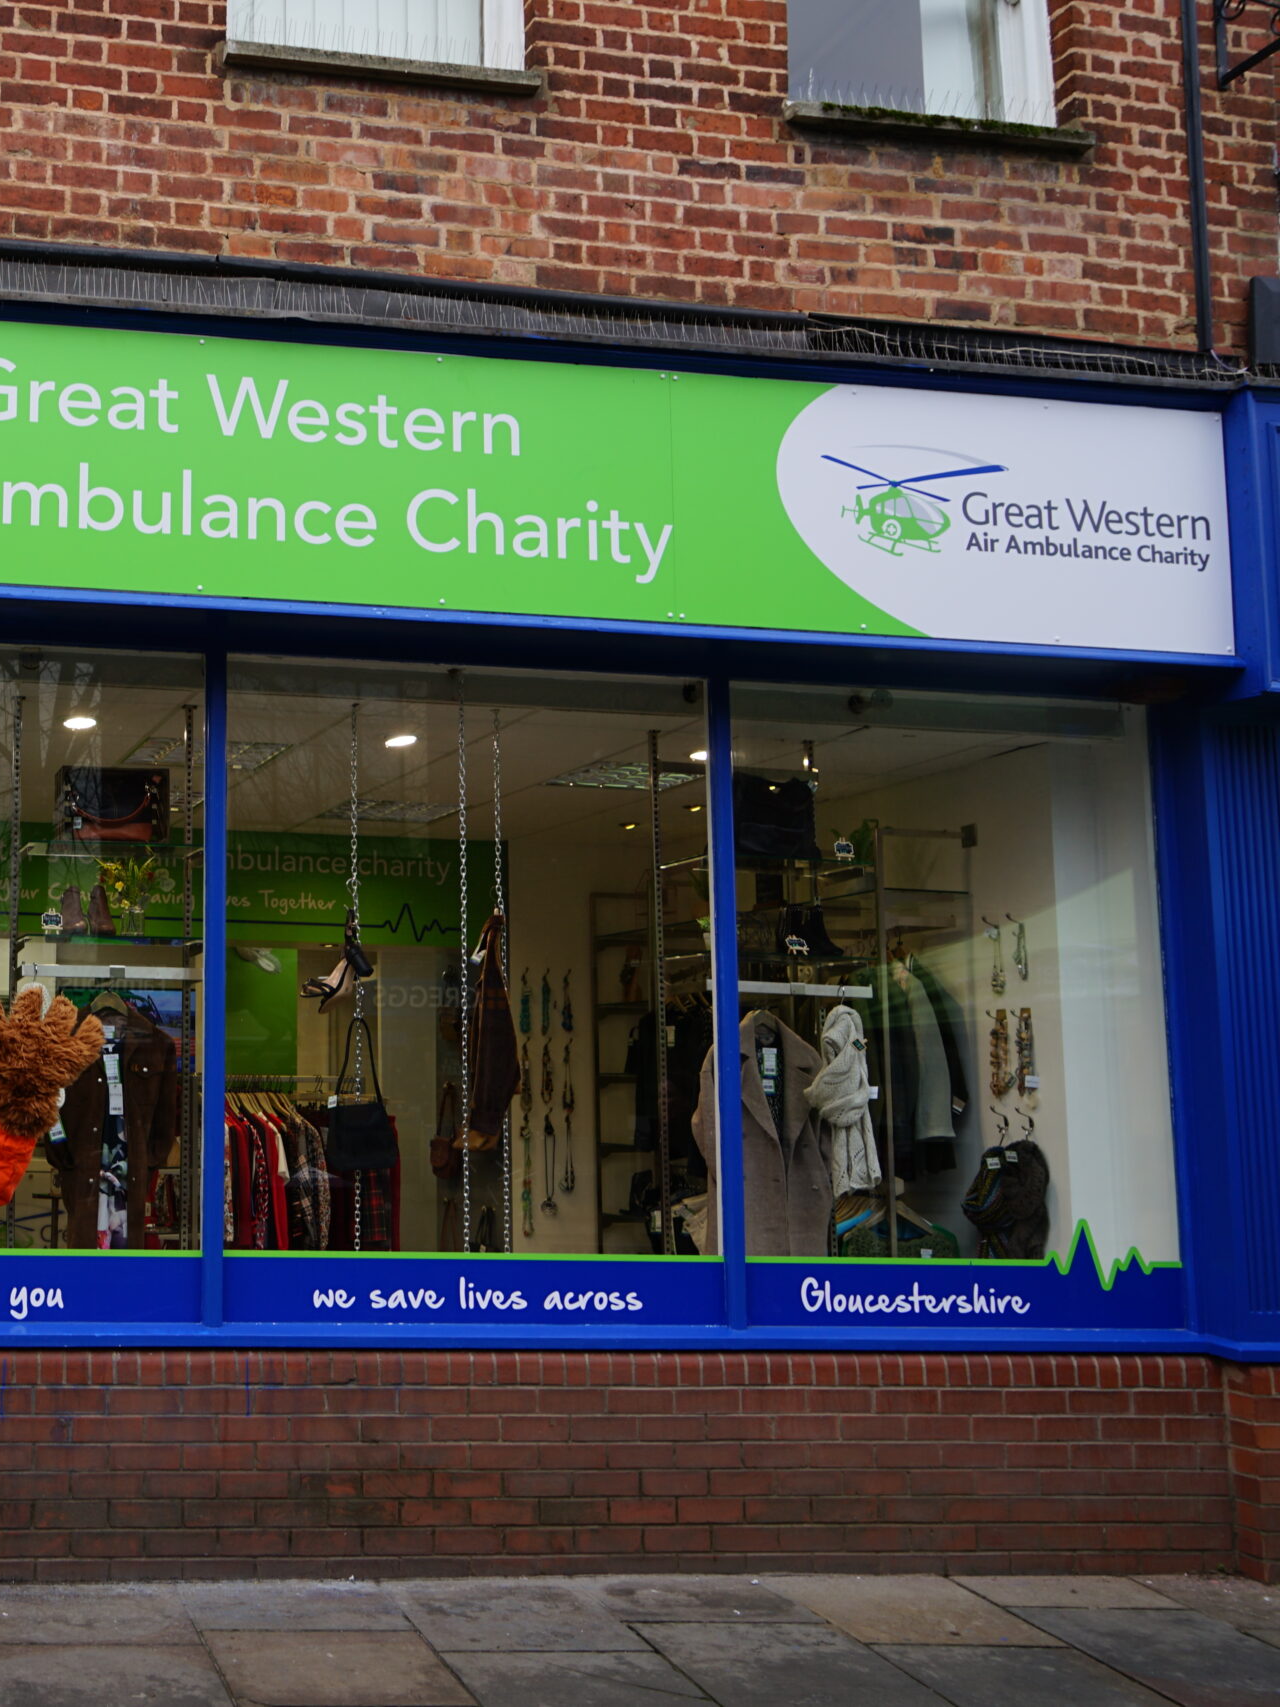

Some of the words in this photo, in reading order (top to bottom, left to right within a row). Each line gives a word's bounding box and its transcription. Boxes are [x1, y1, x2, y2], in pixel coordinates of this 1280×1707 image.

[206, 373, 521, 456] Western
[961, 491, 1059, 530] Great
[1065, 498, 1211, 541] Western
[406, 488, 673, 584] Charity
[966, 532, 999, 553] Air
[1005, 534, 1132, 562] Ambulance
[1137, 544, 1210, 571] Charity
[357, 851, 451, 886] charity
[257, 888, 336, 915] Together
[10, 1286, 64, 1320] you
[313, 1288, 356, 1309] we
[369, 1288, 446, 1310] save
[459, 1276, 528, 1310] lives
[543, 1290, 644, 1311] across
[800, 1276, 1032, 1315] Gloucestershire
